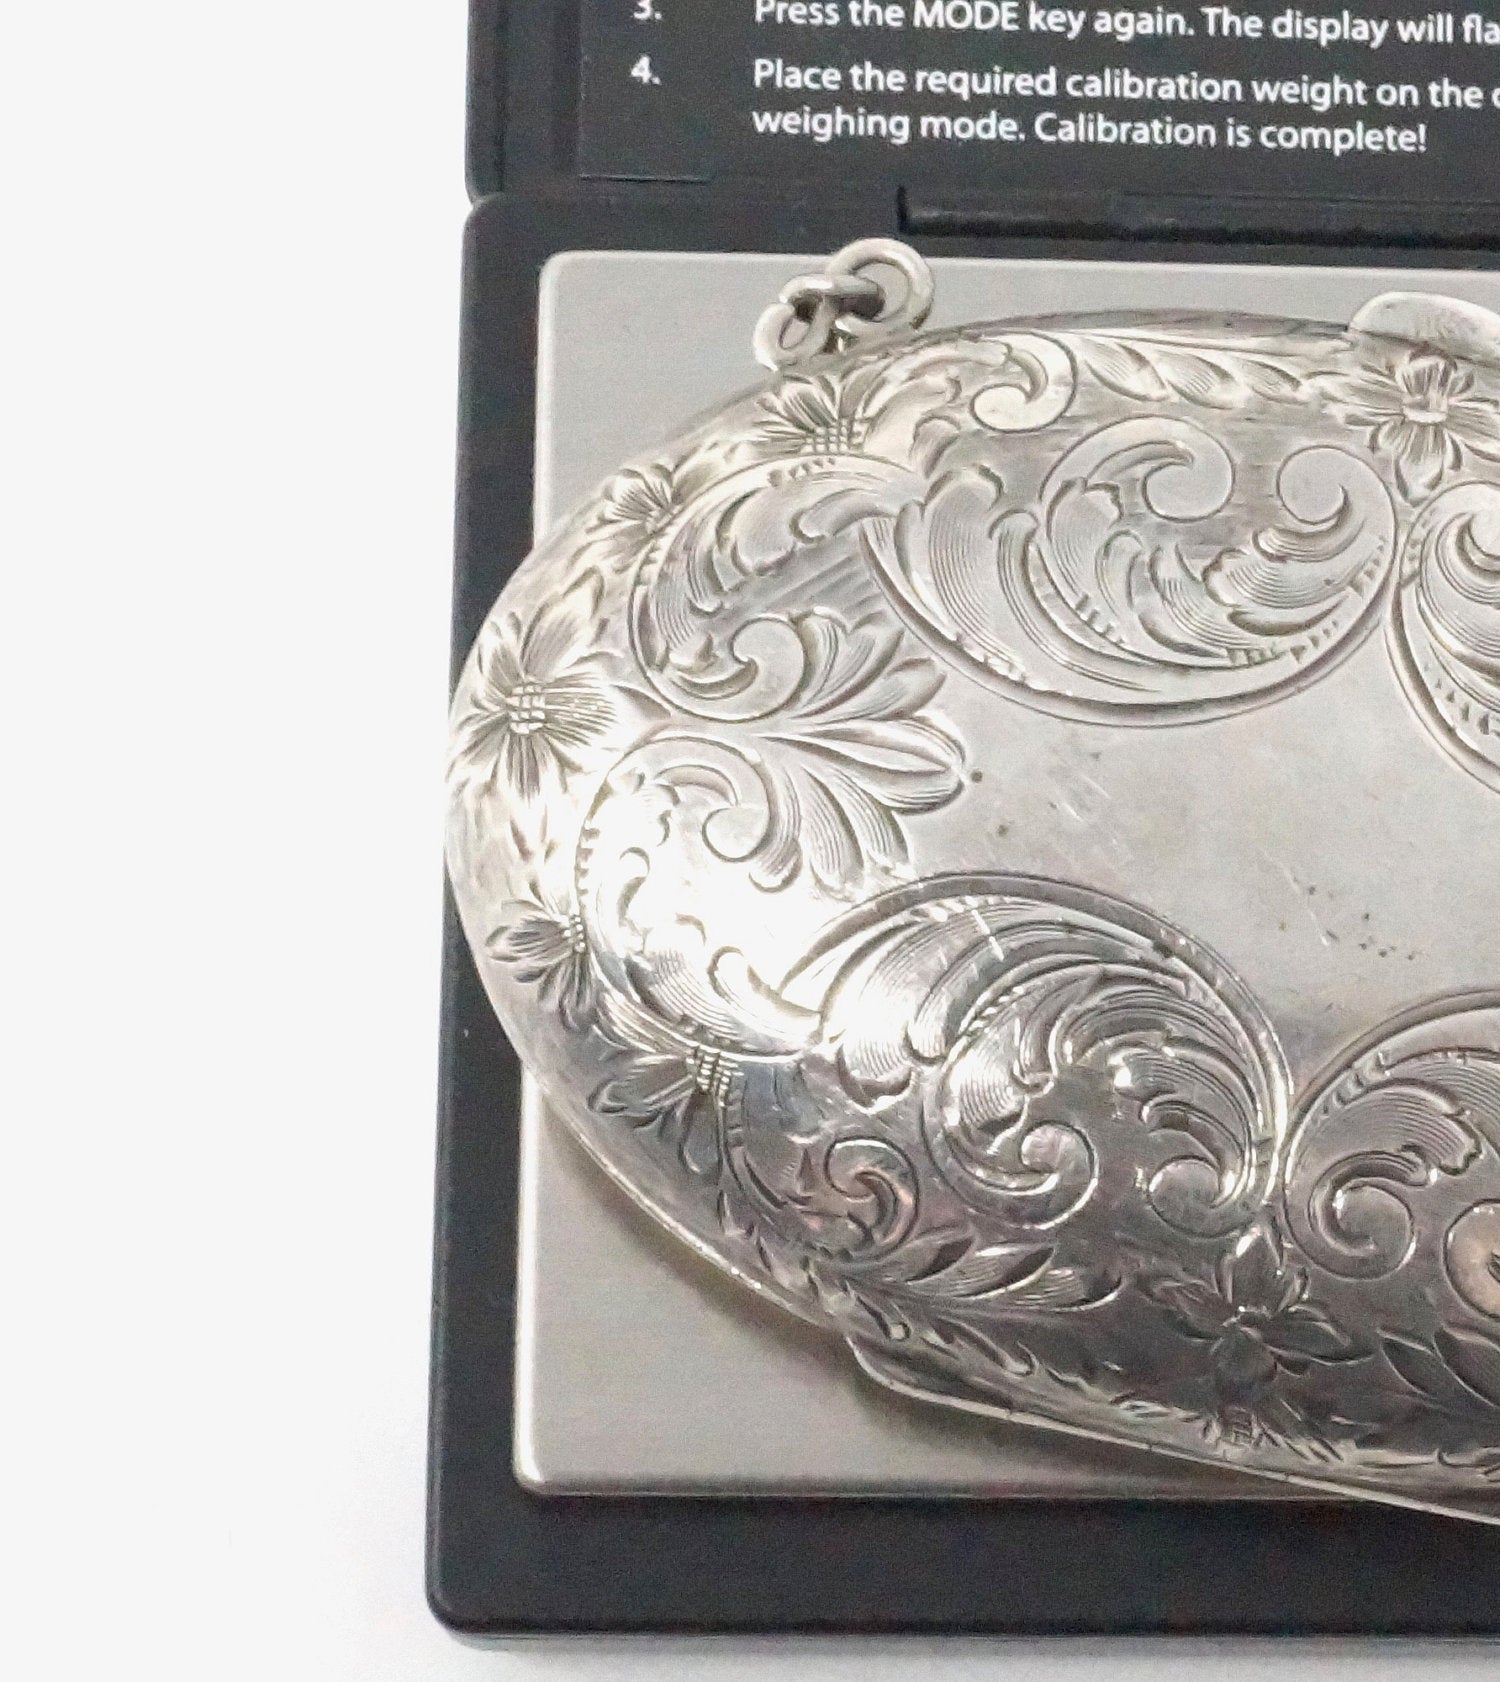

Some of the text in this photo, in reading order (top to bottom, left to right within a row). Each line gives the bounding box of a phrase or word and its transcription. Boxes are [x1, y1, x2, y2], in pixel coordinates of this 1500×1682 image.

[755, 0, 841, 26] Press
[847, 0, 906, 27] the
[912, 0, 1020, 32] MODE
[1028, 0, 1087, 40] key
[1093, 6, 1195, 42] again.
[1201, 6, 1264, 38] The
[1270, 9, 1390, 48] display
[1396, 13, 1454, 44] will
[630, 55, 662, 85] 4.
[753, 58, 843, 90] Place
[848, 61, 908, 92] the
[914, 65, 1058, 101] required
[1065, 68, 1243, 102] calibration
[1250, 73, 1368, 112] weight
[1375, 83, 1420, 107] on
[1427, 78, 1484, 109] the
[751, 105, 1427, 157] weighing mode. Calibration is complete!
